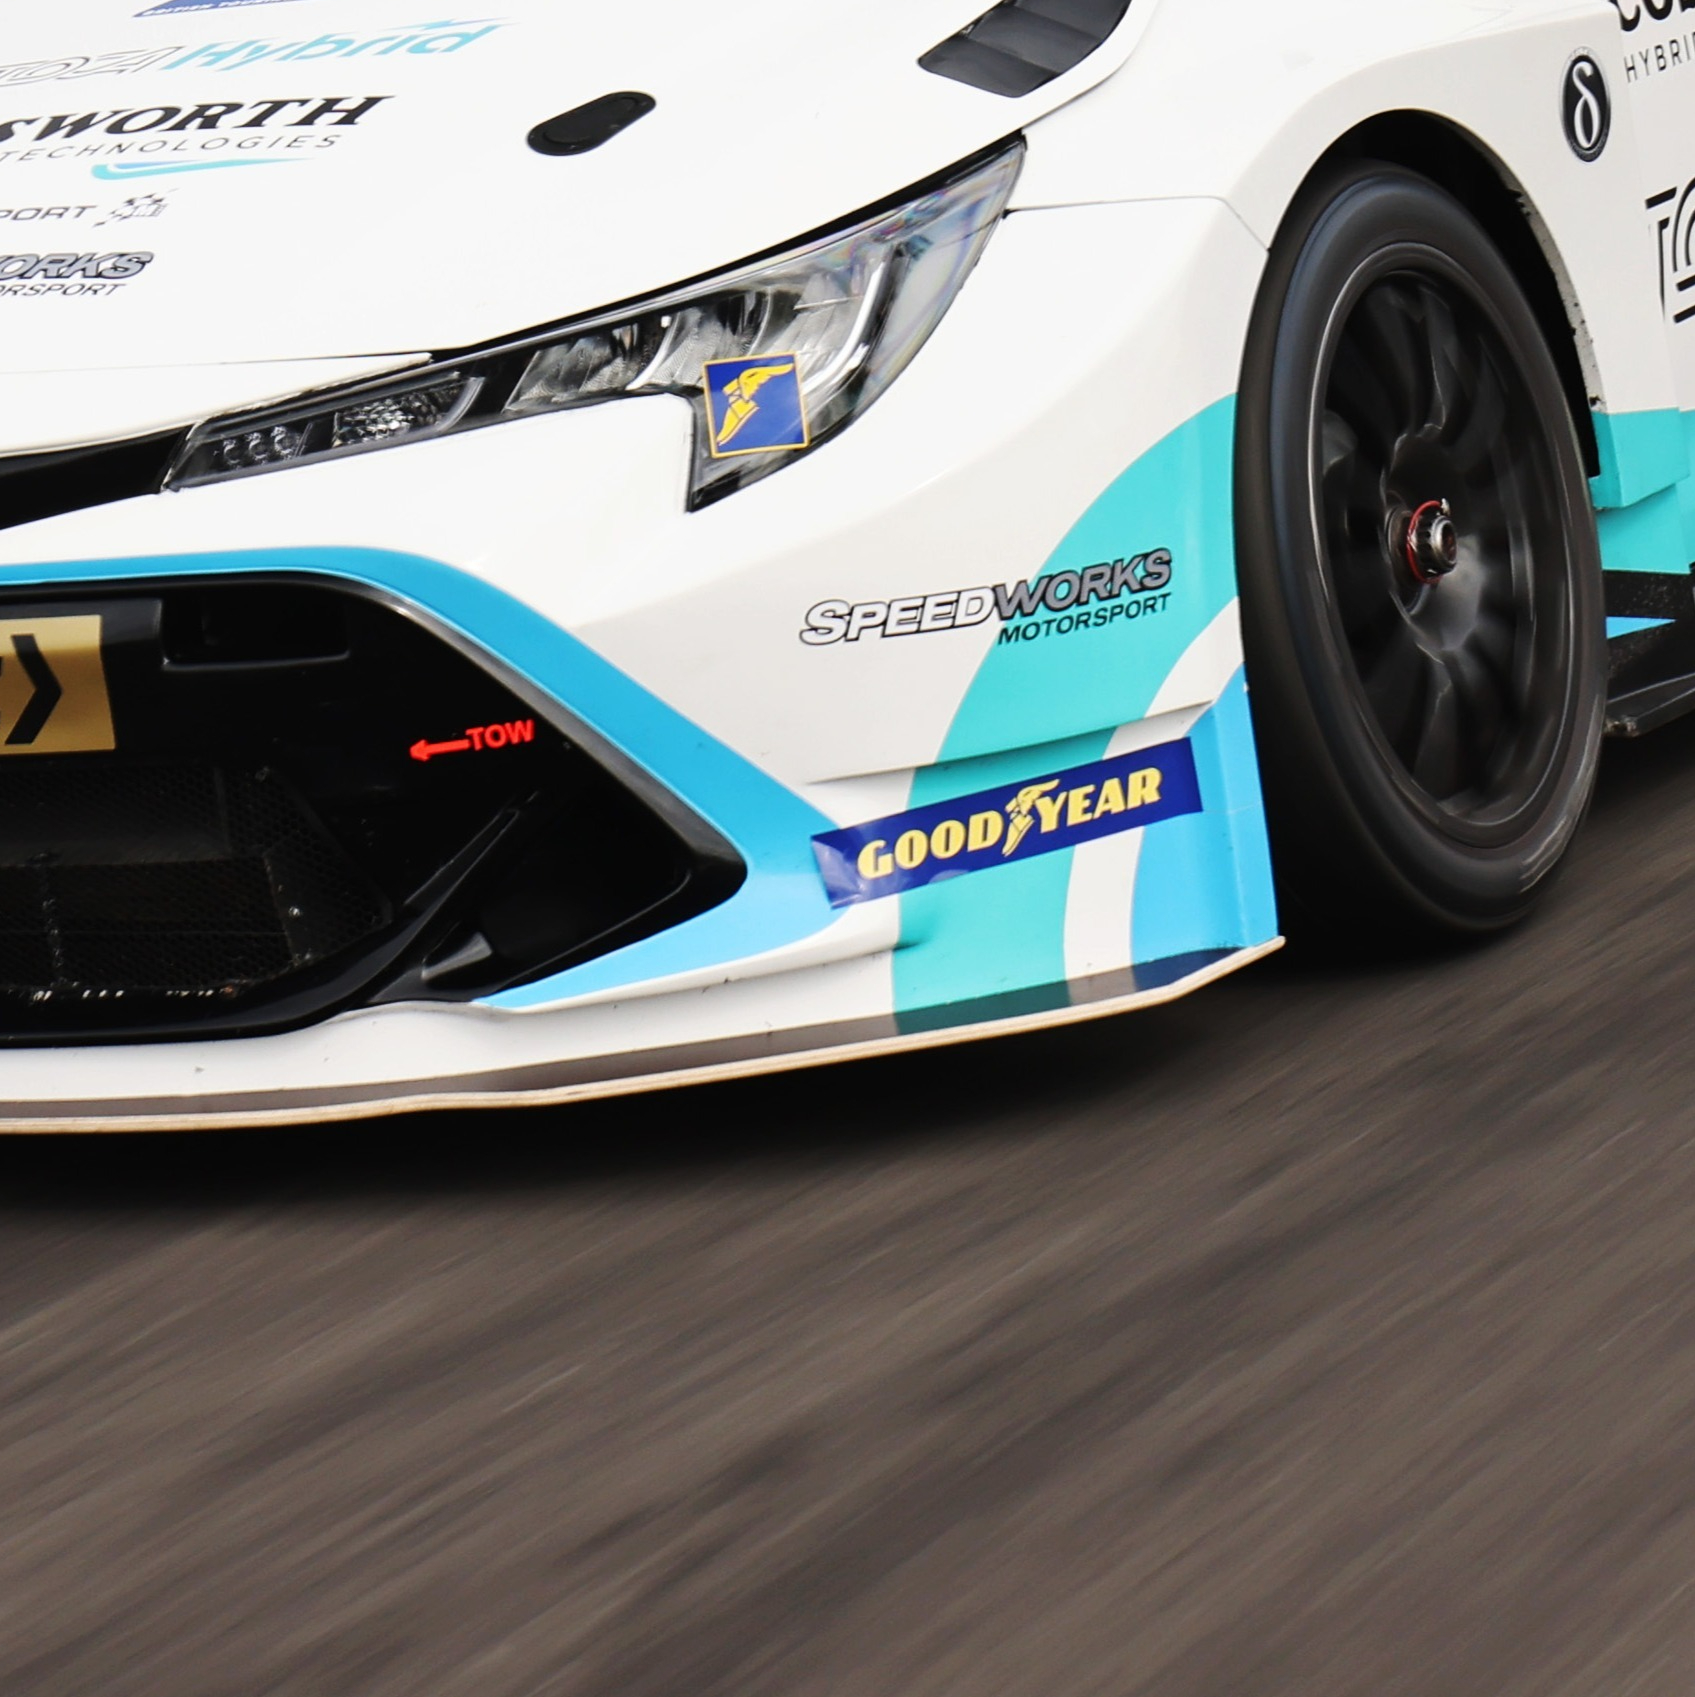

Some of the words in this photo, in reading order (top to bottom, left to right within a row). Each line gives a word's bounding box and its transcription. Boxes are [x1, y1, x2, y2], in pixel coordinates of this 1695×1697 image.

[799, 547, 1172, 646] SPEEDWORKS
[997, 592, 1172, 646] MOTORSPORT
[465, 719, 535, 751] TOW
[856, 766, 1163, 881] GOODYEAR
